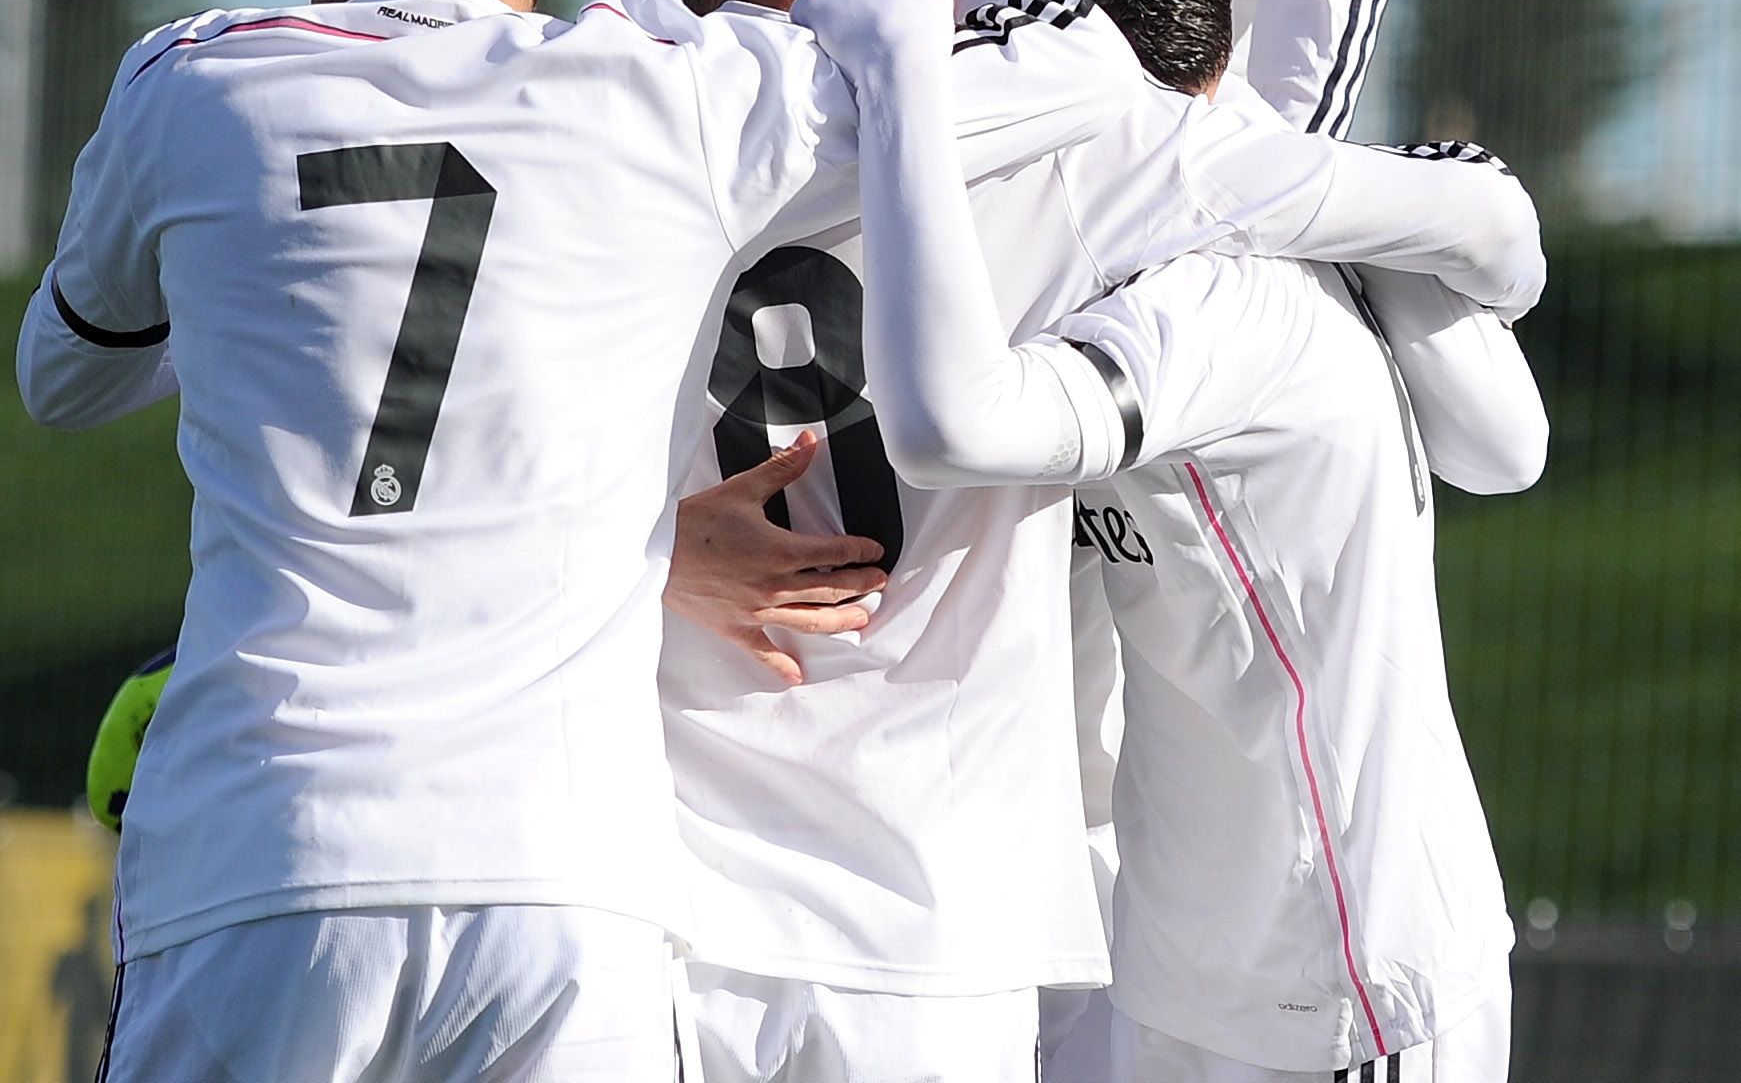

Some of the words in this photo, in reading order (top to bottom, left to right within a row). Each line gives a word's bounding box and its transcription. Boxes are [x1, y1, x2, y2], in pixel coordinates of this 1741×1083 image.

[377, 6, 409, 23] REAL
[410, 13, 454, 29] MADR
[297, 142, 497, 517] 7
[707, 245, 904, 576] 8
